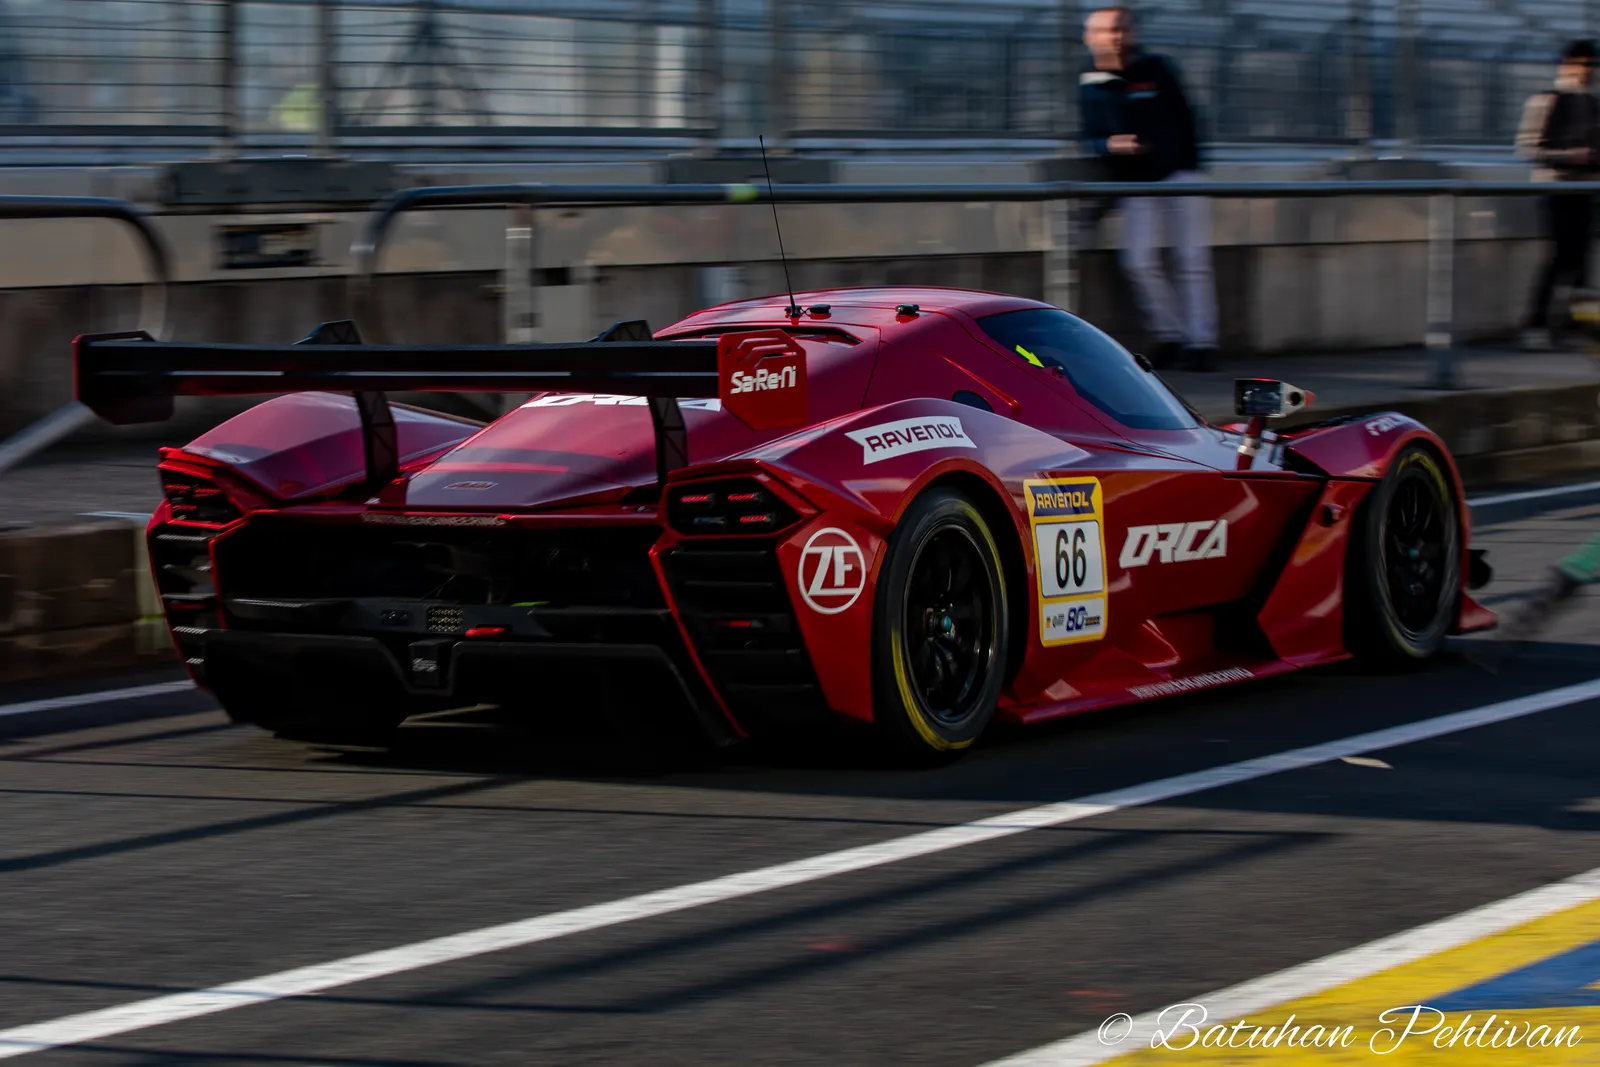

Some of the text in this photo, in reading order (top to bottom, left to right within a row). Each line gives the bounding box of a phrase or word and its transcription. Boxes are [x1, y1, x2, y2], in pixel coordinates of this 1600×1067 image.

[864, 423, 965, 452] RAVENOL
[1035, 490, 1090, 509] RAVENOL
[1055, 527, 1087, 589] 66
[1118, 518, 1229, 569] ORCA
[802, 543, 862, 598] ZF
